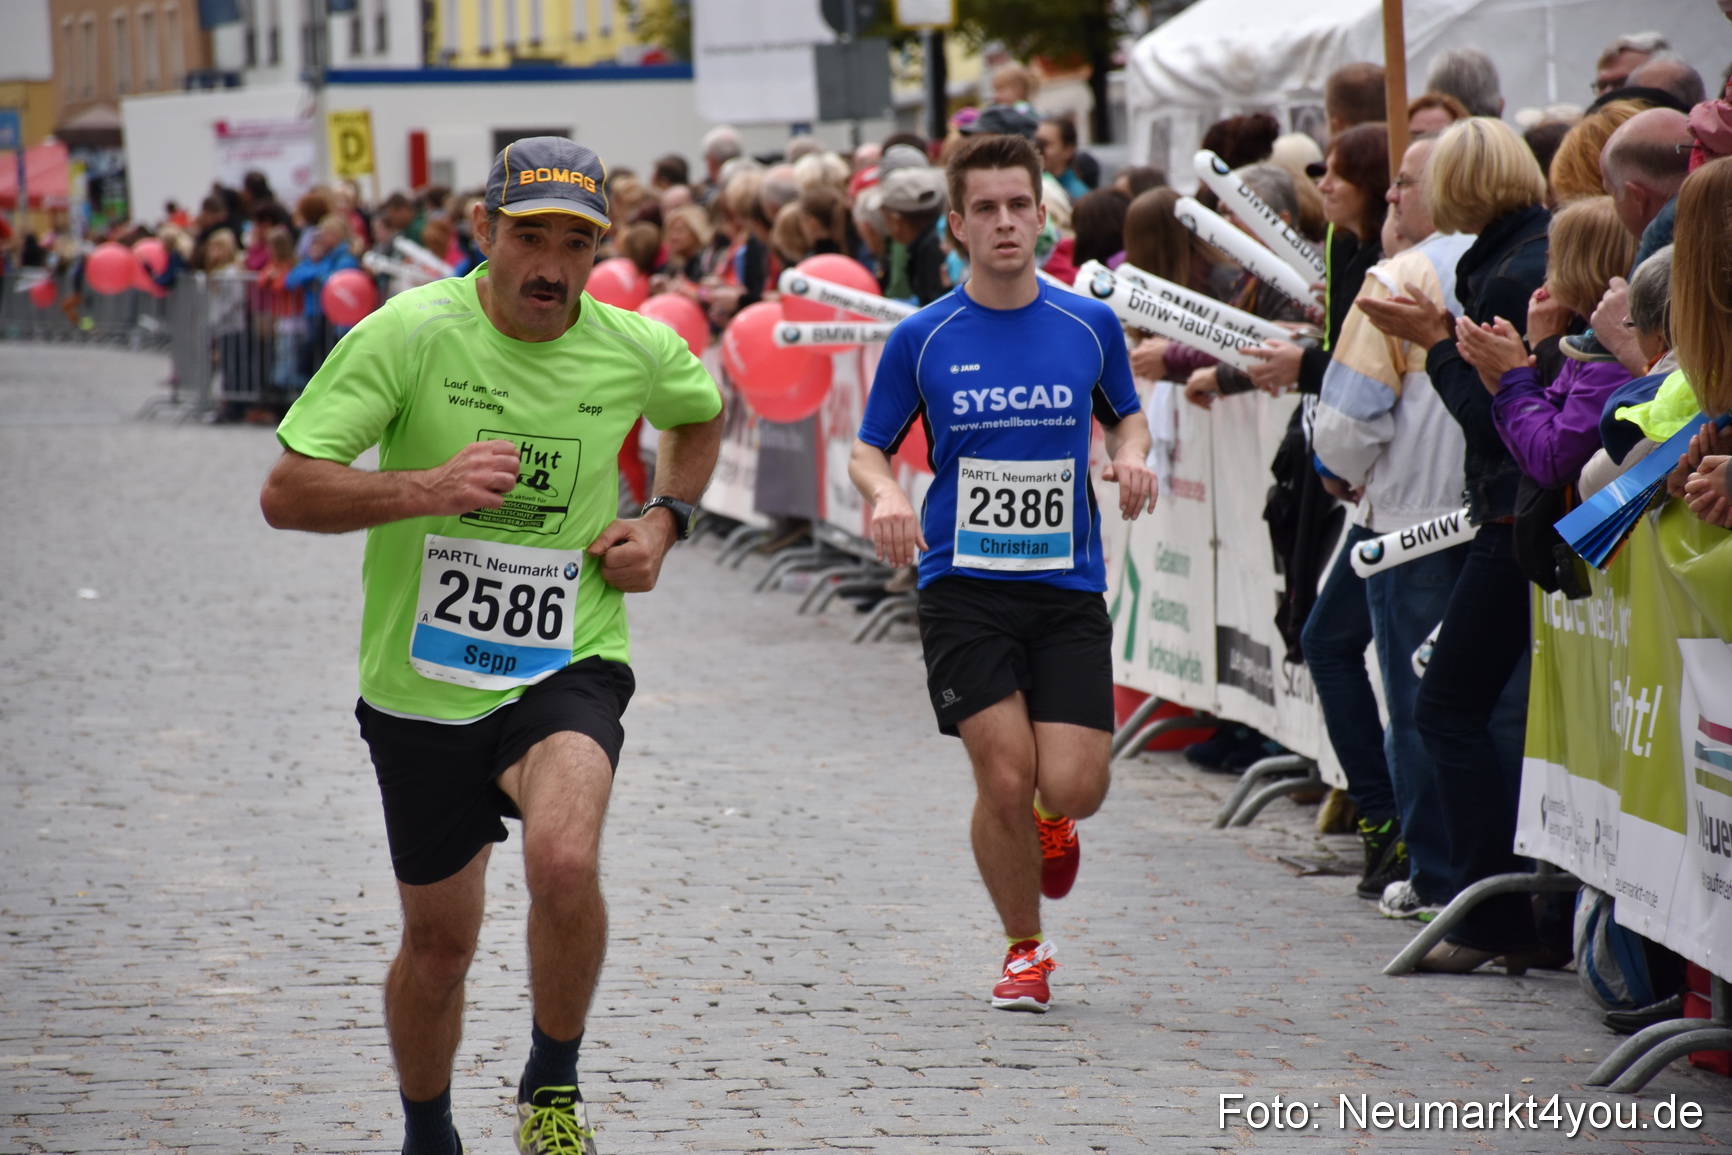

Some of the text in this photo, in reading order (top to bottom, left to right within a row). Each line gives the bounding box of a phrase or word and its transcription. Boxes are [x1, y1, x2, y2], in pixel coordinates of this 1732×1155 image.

[339, 128, 366, 164] D
[519, 167, 597, 194] BOMAG
[812, 327, 858, 341] BMW
[960, 363, 980, 372] JAKO
[444, 377, 509, 398] Lauf um den
[448, 394, 504, 415] Wolfsberg
[577, 402, 603, 416] Sepp
[952, 384, 1074, 416] SYSCAD
[950, 415, 1077, 432] www.metallbau-cad.de
[520, 441, 562, 469] Hut
[961, 468, 1057, 482] PARTL Neumarkt
[968, 486, 1064, 528] 2386
[1401, 513, 1459, 550] BMW
[981, 538, 1048, 554] Christian
[428, 549, 559, 578] PARTL Neumarkt
[422, 613, 429, 622] A
[434, 570, 565, 641] 2586
[464, 645, 517, 675] Sepp
